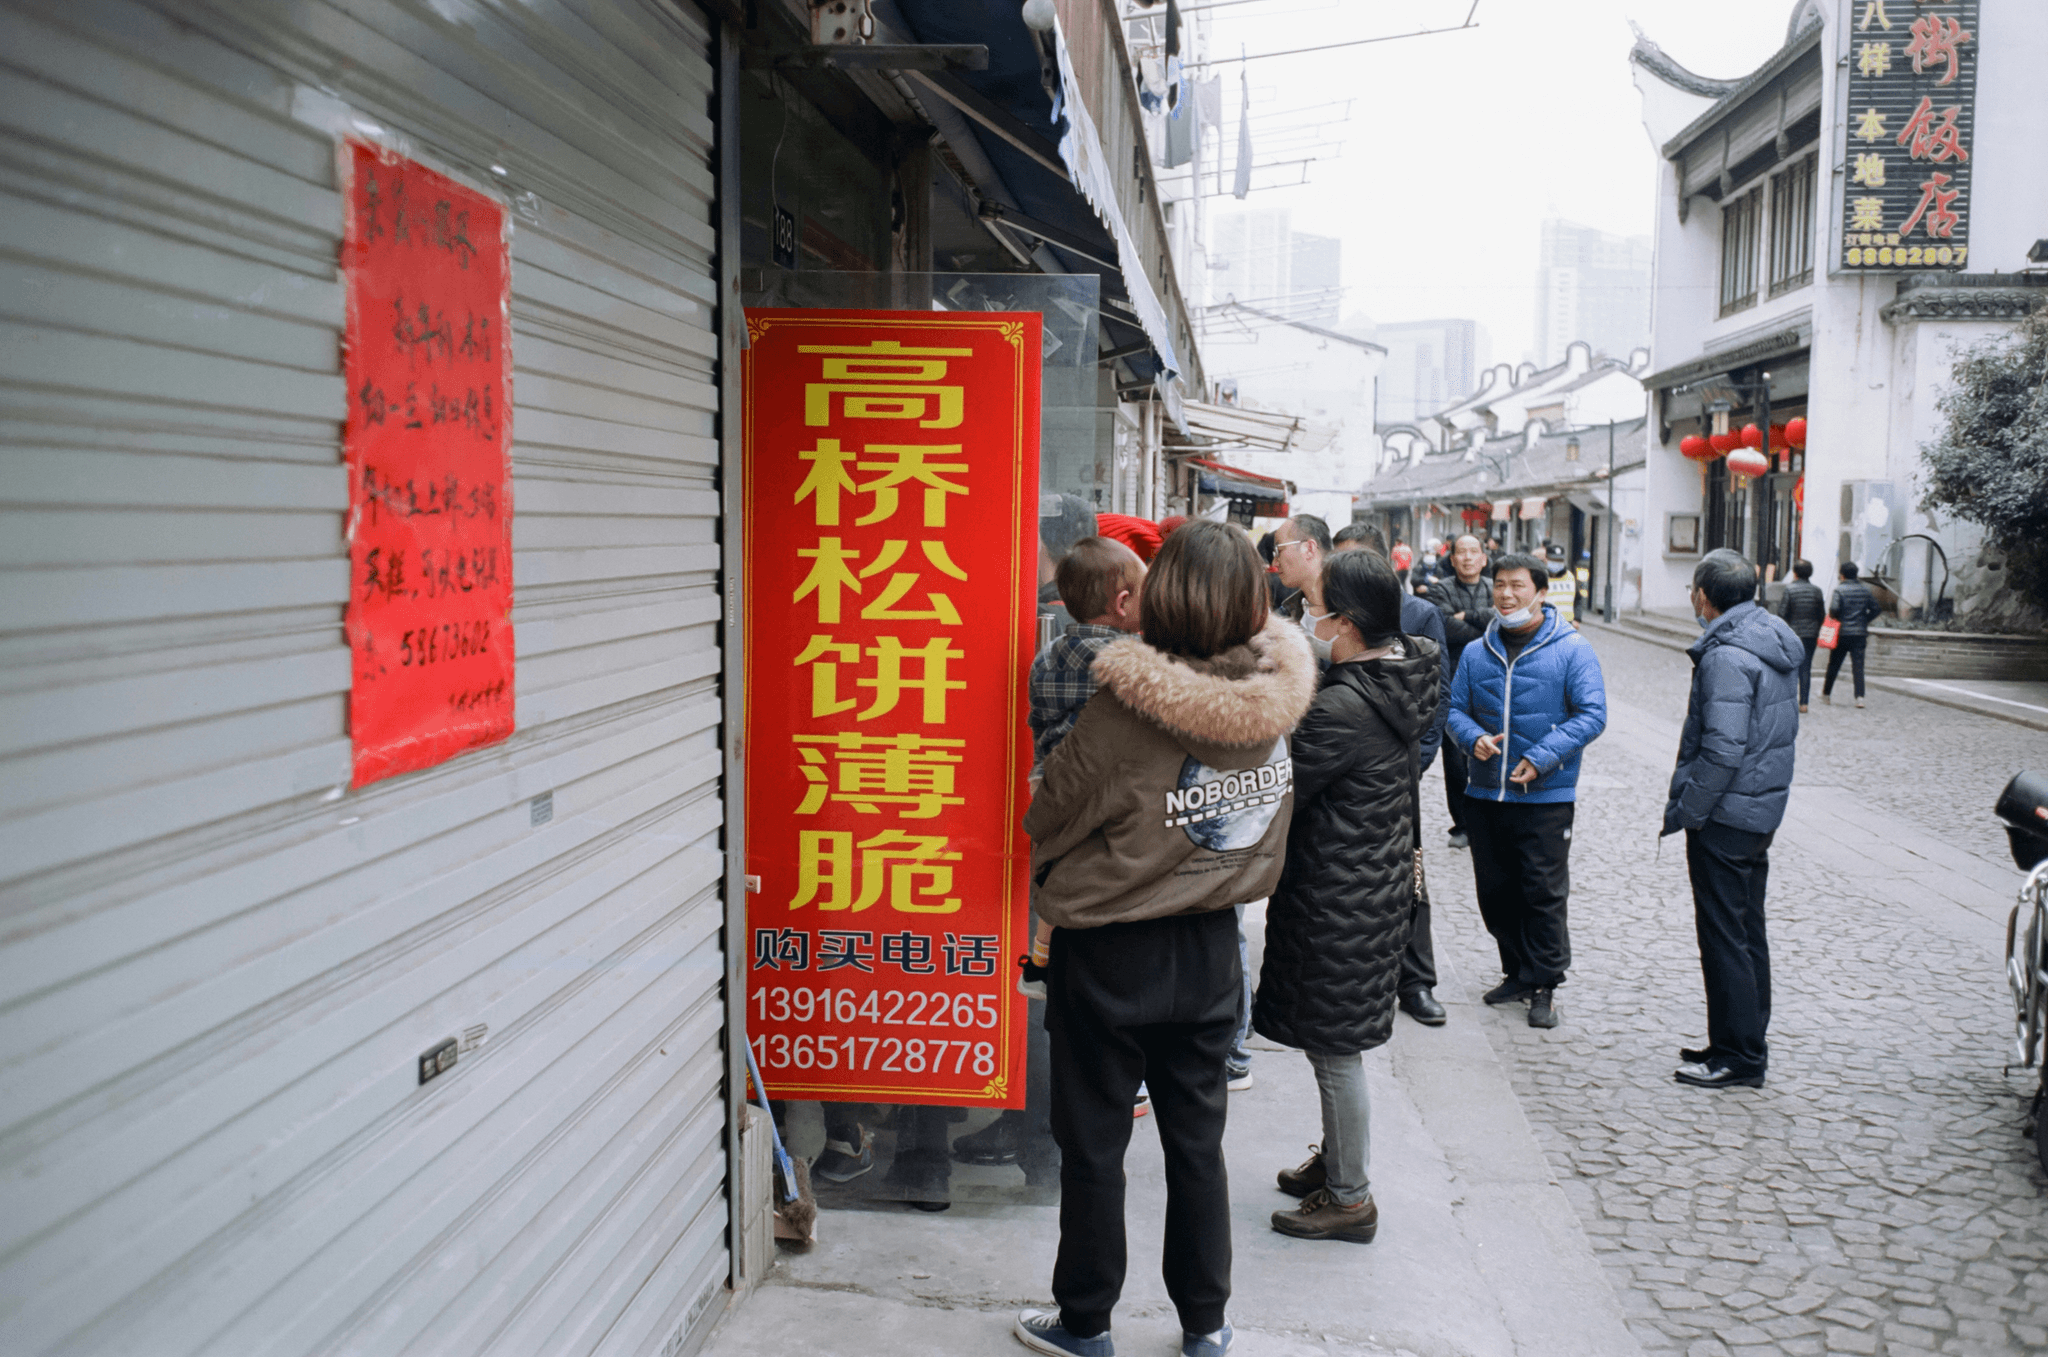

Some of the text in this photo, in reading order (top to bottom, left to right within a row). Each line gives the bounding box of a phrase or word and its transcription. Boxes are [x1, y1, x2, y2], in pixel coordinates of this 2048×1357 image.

[1896, 0, 1970, 239] 街饭店
[1851, 107, 1888, 231] 本地菜
[775, 213, 793, 253] 188
[788, 340, 974, 915] 高桥松饼薄脆
[753, 927, 1000, 977] 购买电话
[751, 986, 998, 1029] 13916422265
[751, 1034, 995, 1076] 13651728778
